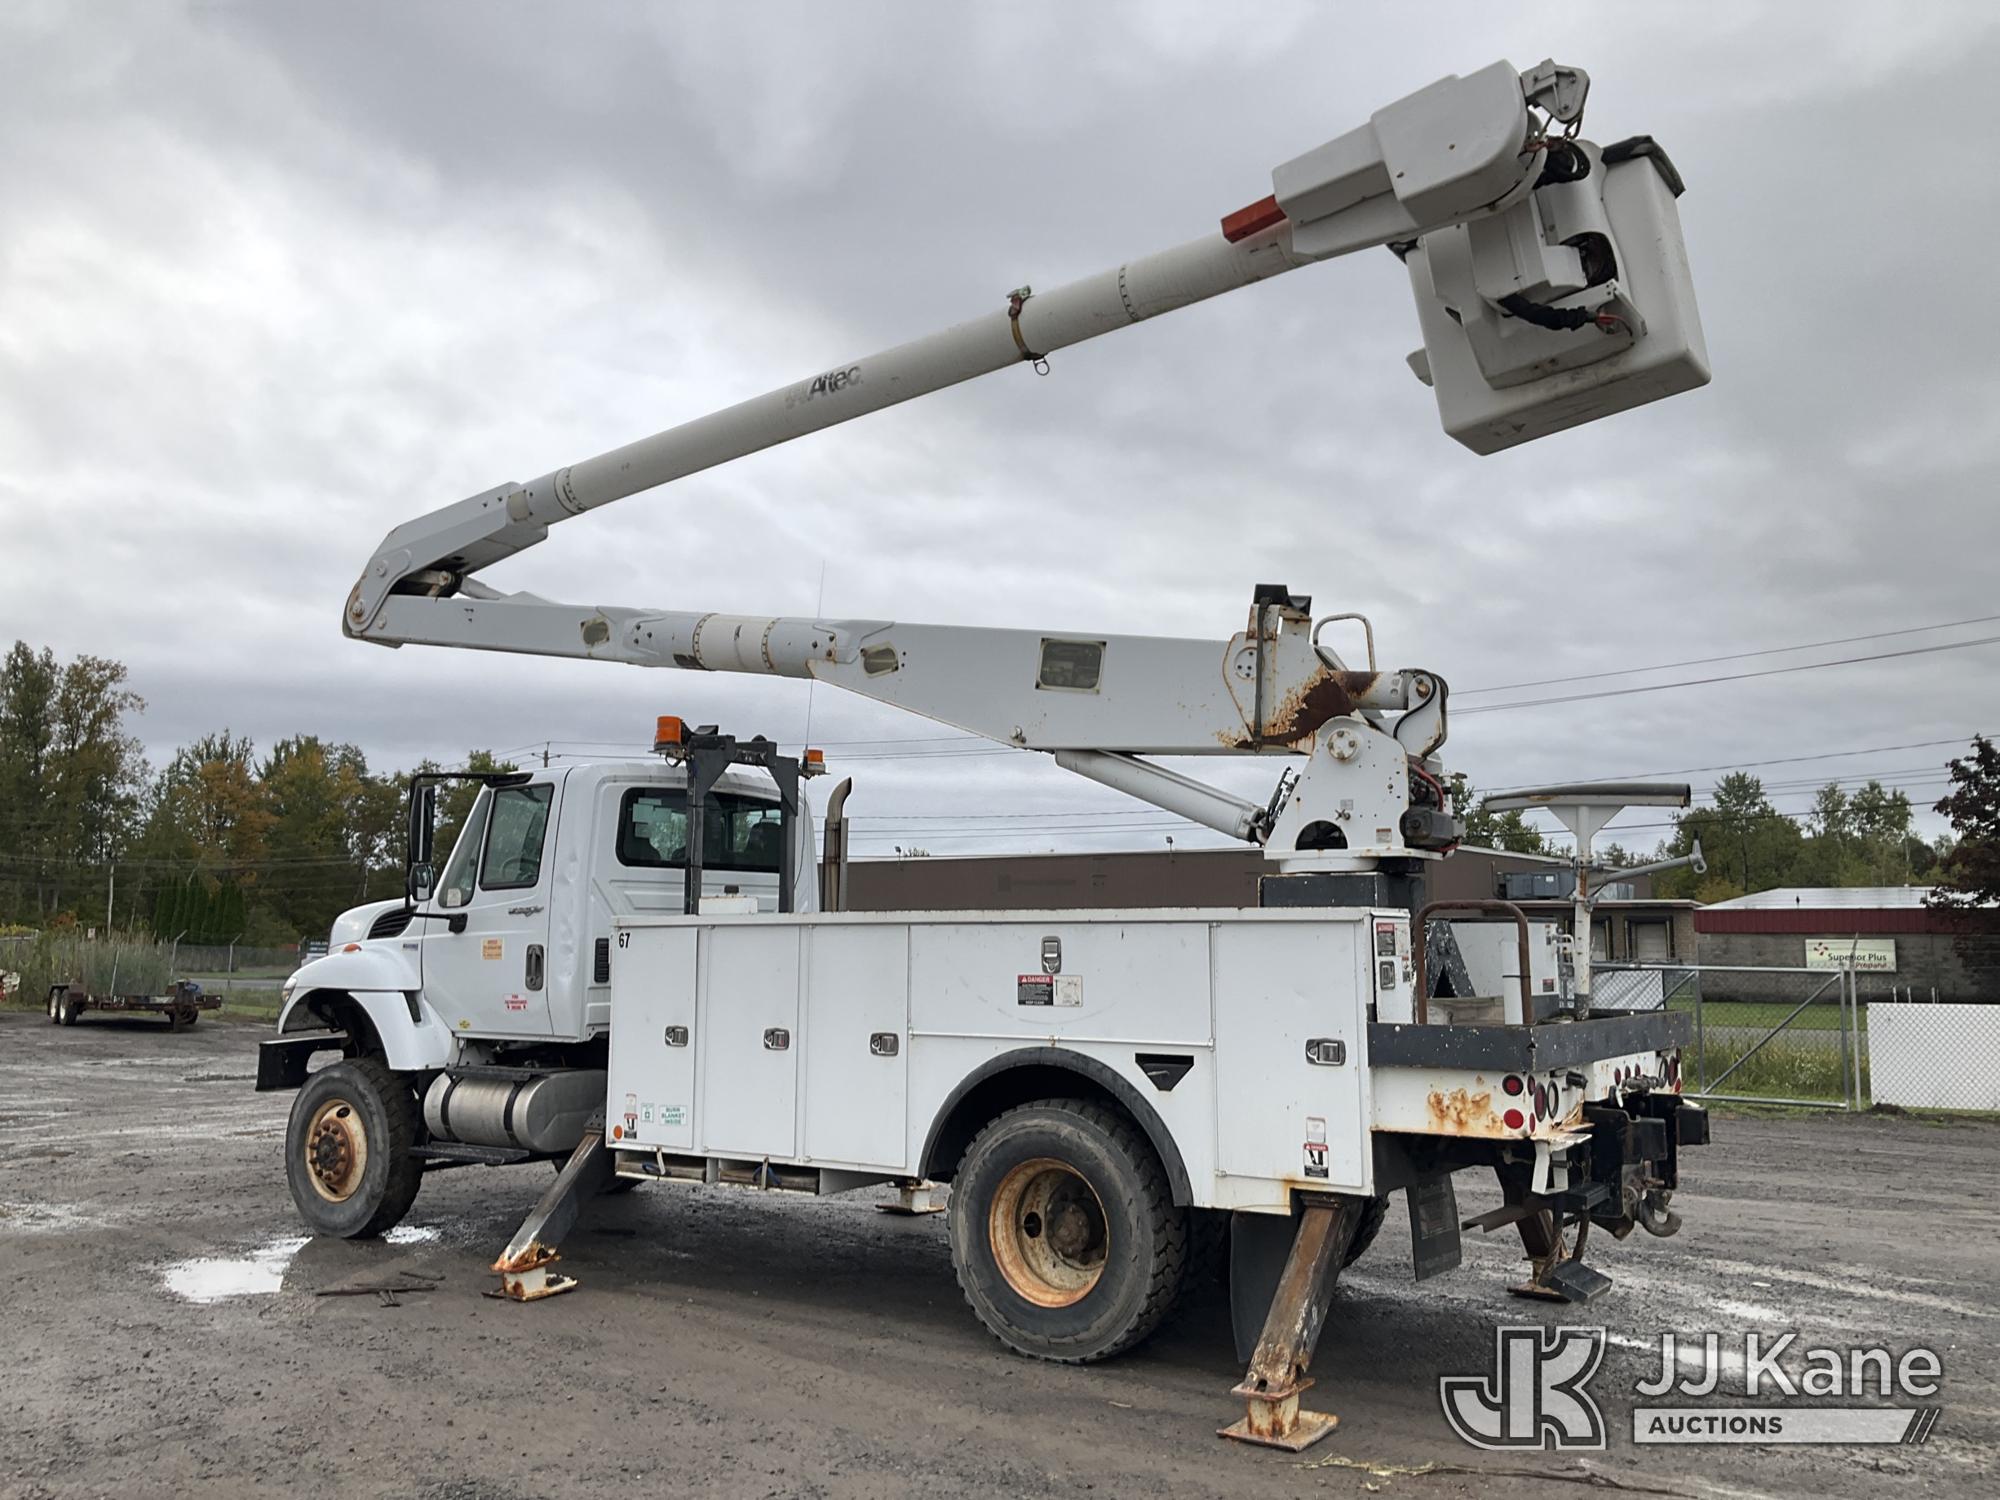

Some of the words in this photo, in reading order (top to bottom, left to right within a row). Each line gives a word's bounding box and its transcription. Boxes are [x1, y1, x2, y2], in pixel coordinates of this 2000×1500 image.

[618, 932, 631, 949] 67
[1828, 952, 1866, 963] Supeor
[1868, 952, 1887, 962] Plus
